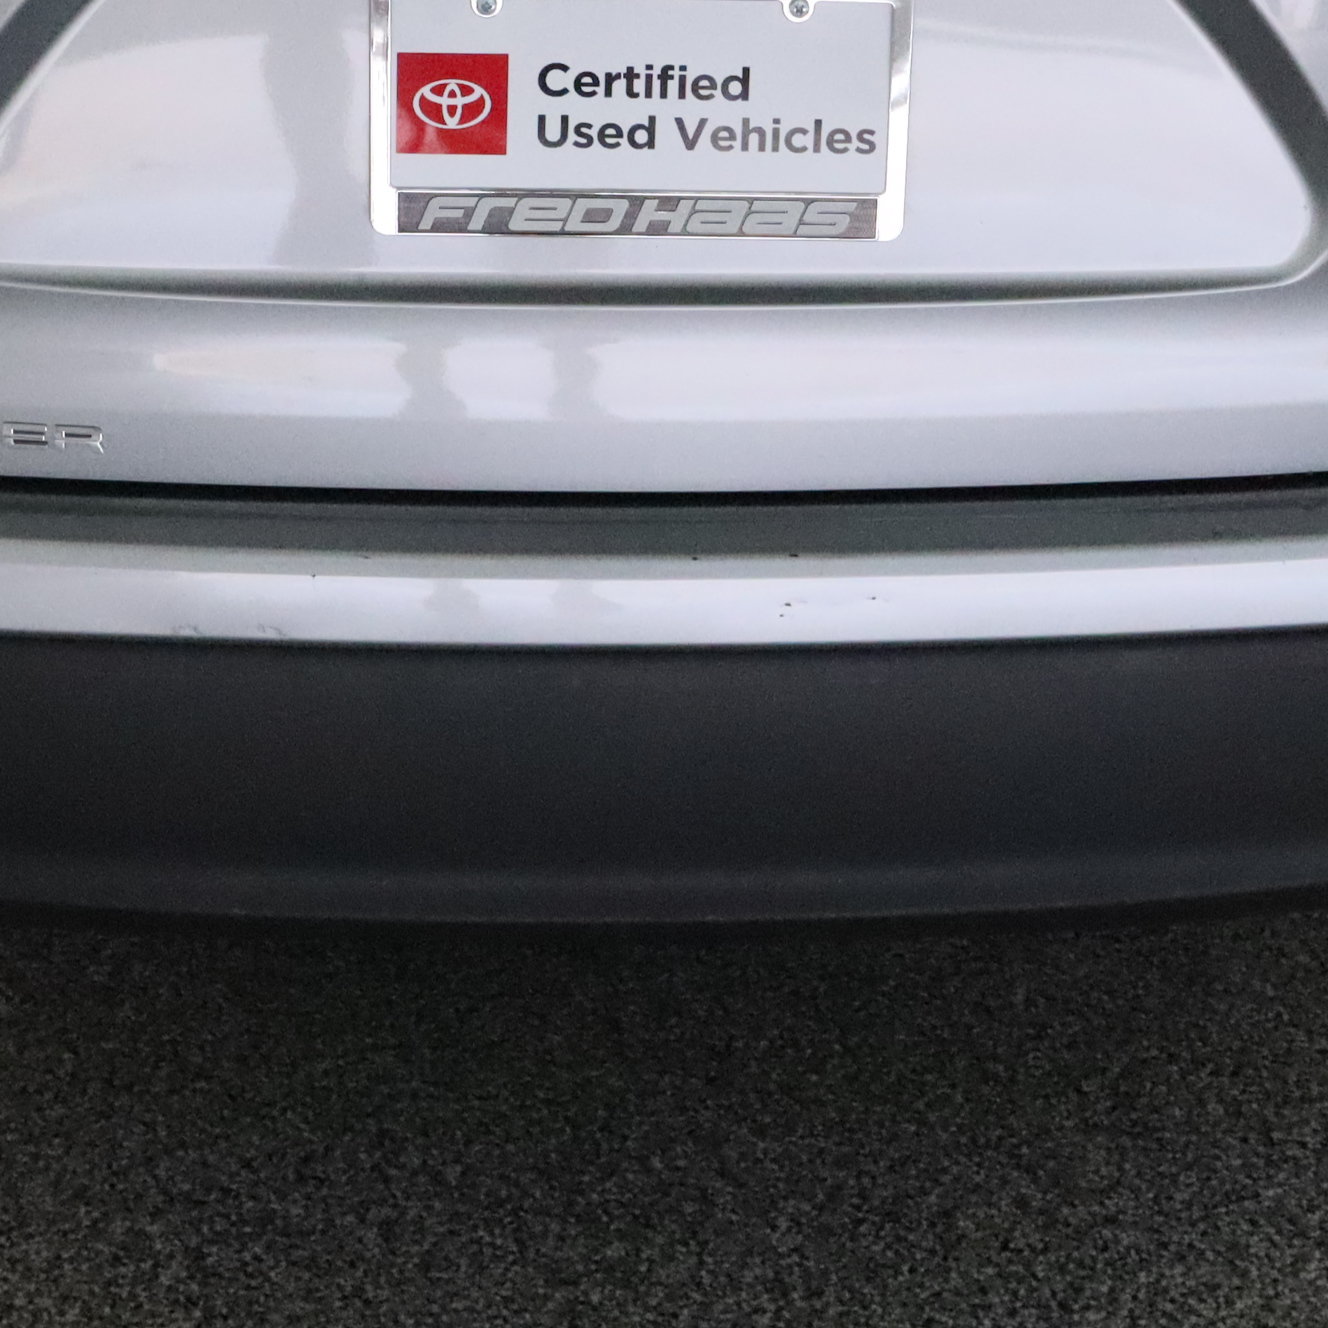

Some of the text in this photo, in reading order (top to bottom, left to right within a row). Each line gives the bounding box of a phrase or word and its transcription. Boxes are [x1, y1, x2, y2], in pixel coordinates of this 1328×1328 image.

[537, 62, 751, 102] Certified
[537, 114, 877, 156] Used Vehicles
